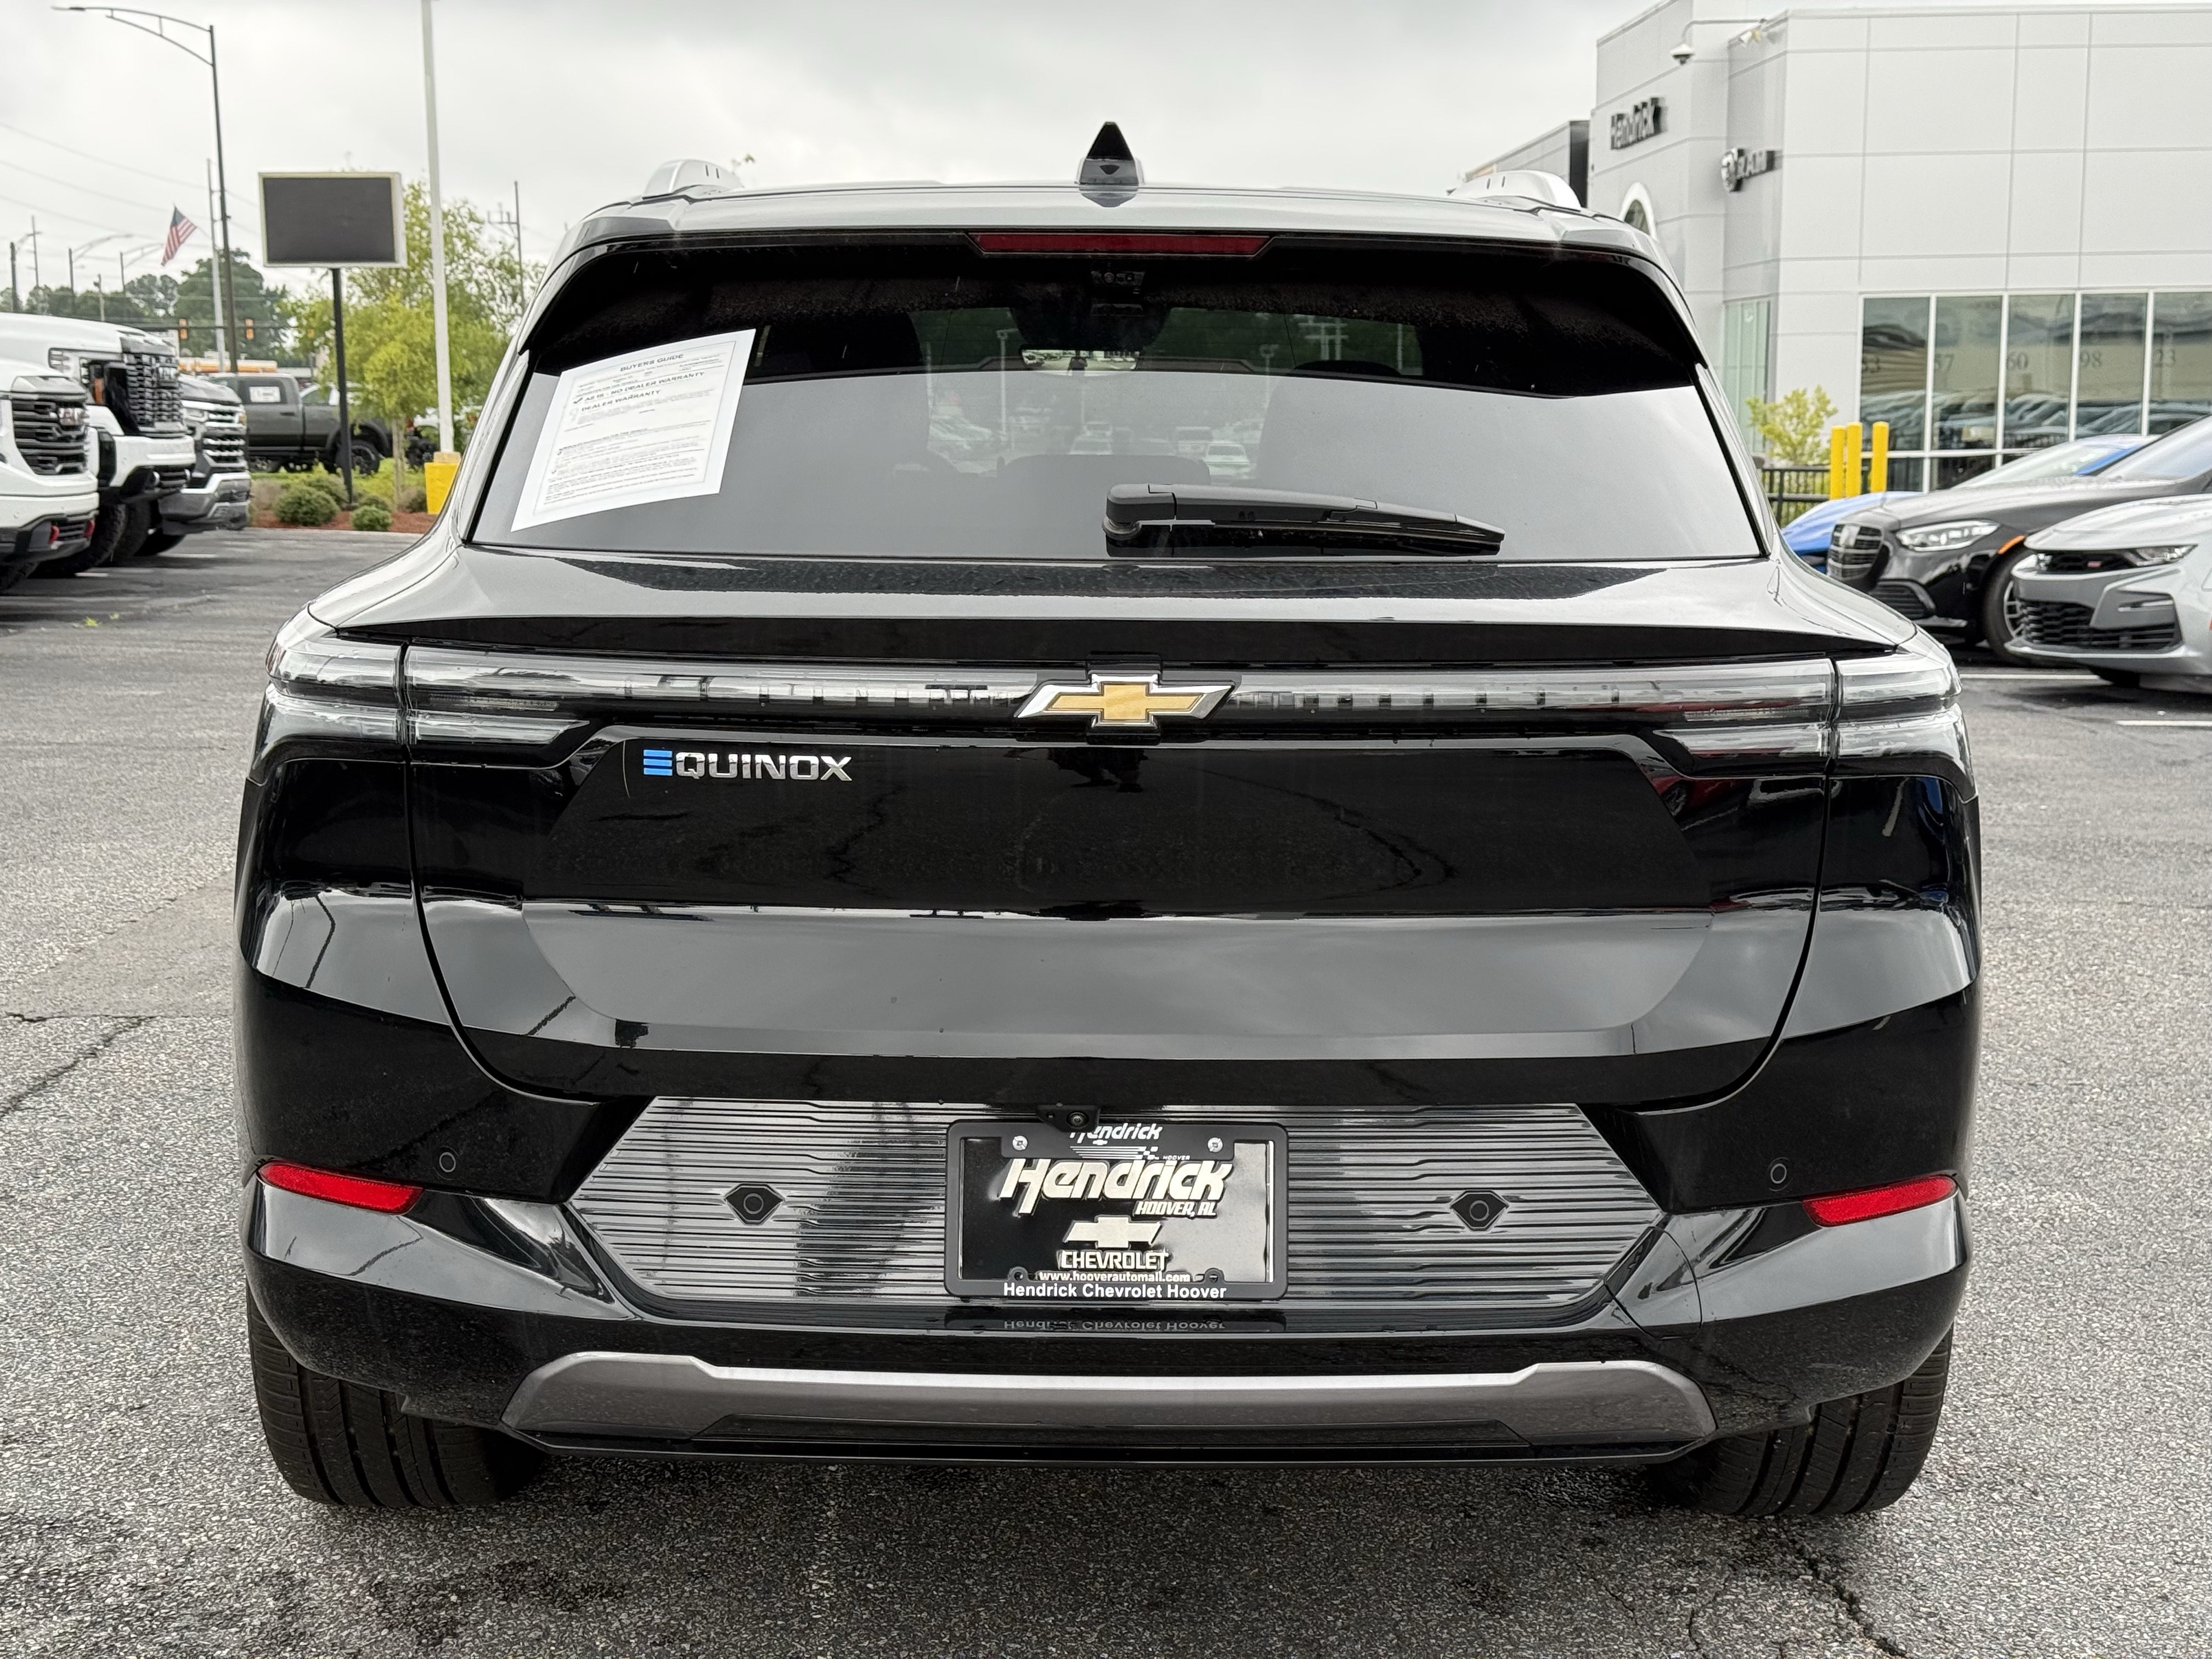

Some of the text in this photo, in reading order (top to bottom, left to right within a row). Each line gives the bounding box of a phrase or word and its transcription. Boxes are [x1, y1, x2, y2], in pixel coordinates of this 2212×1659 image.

[620, 360, 654, 371] BUYERS
[657, 353, 684, 363] GUIDE
[624, 381, 656, 391] DEALER
[658, 372, 704, 385] WARRANTY
[582, 400, 613, 411] DEALER
[615, 390, 661, 403] WARRANTY
[643, 749, 853, 782] EQUINOX
[998, 1158, 1233, 1215] Hendrick
[1135, 1201, 1216, 1217] HOOVER, AL
[1060, 1251, 1169, 1270] CHEVROLET
[1039, 1271, 1190, 1283] www.hooverautomall.com
[1003, 1282, 1227, 1299] Hendrick Chevrolet Hoover
